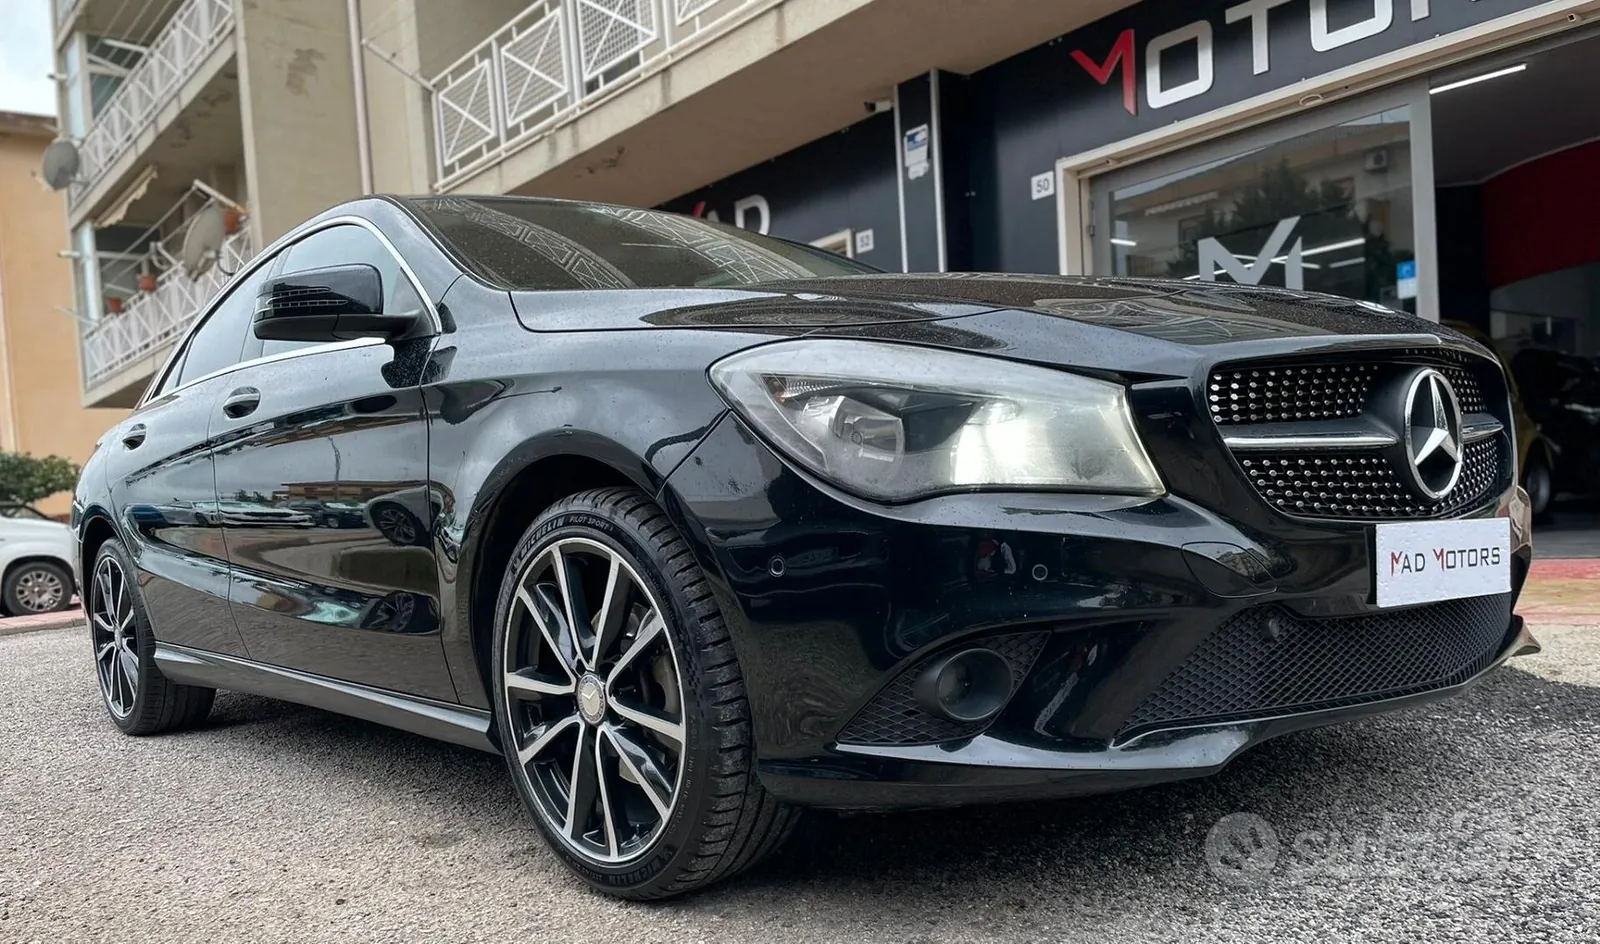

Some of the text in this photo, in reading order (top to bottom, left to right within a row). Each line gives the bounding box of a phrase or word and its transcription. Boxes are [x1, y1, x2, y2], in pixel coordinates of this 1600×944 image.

[1070, 0, 1430, 116] MOTO
[1036, 178, 1050, 193] 50
[520, 515, 566, 558] MICHELIN
[588, 517, 609, 530] SPORT
[1391, 547, 1501, 577] MAD MOTORS
[608, 858, 661, 885] MICHELIN
